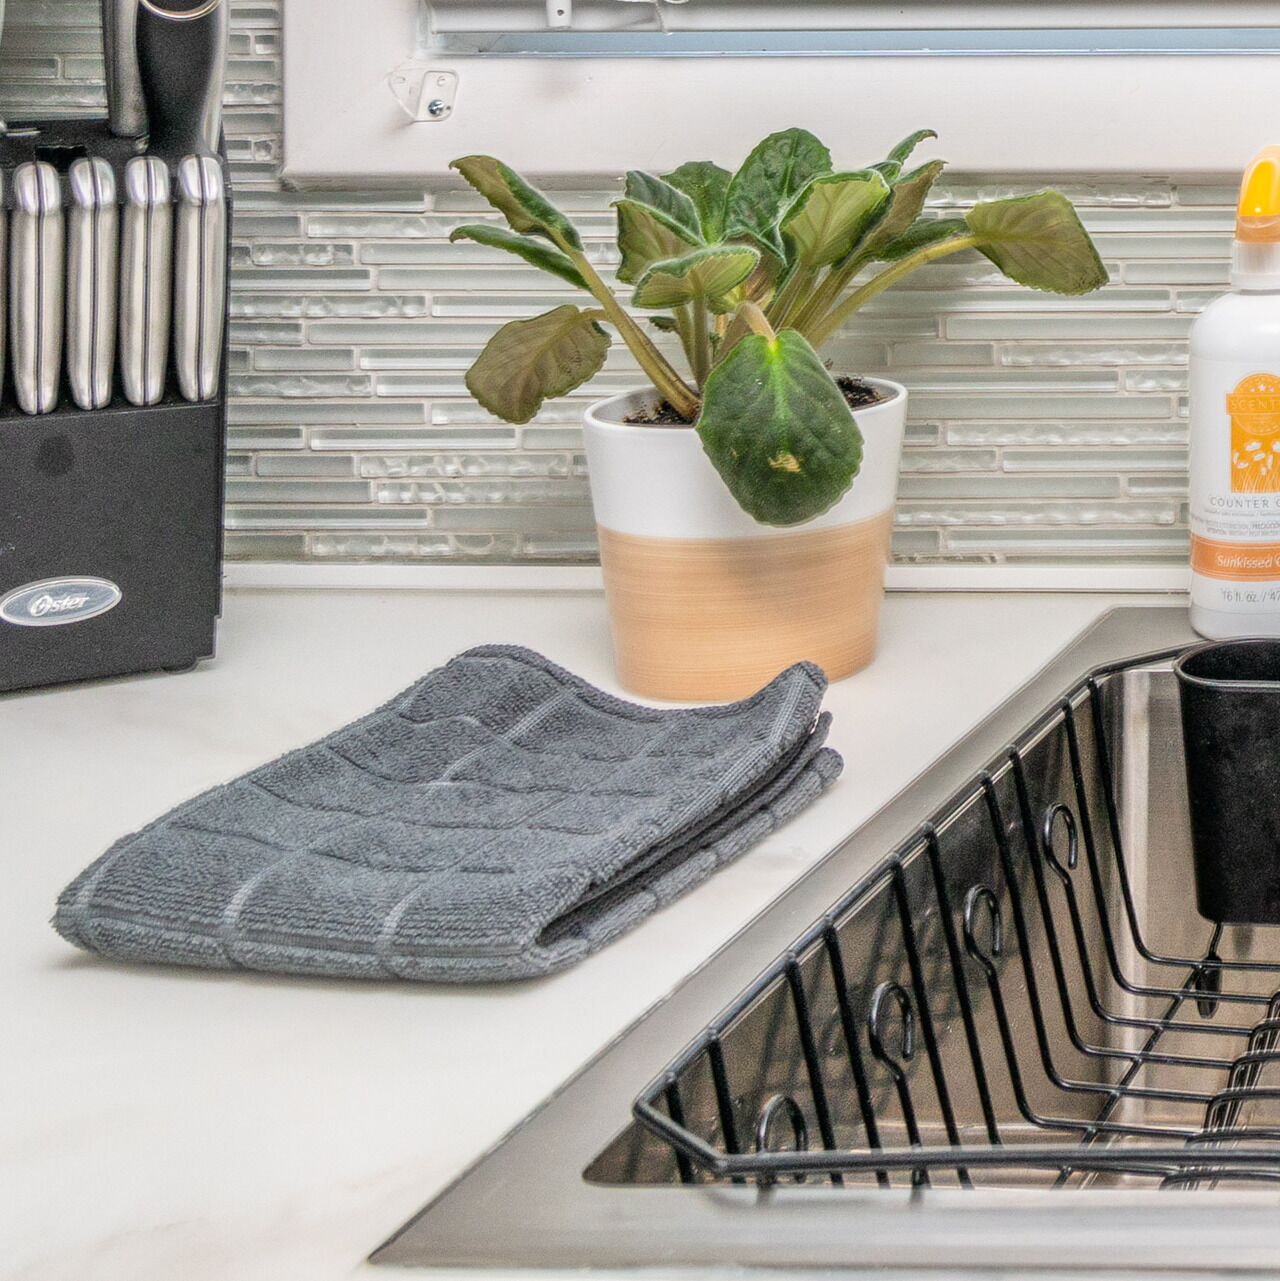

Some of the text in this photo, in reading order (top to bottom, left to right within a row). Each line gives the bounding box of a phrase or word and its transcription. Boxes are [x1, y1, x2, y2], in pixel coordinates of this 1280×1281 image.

[1210, 496, 1269, 509] COUNTER
[1216, 554, 1273, 569] Sunkissed
[1222, 591, 1233, 601] 16
[30, 594, 90, 617] Oster
